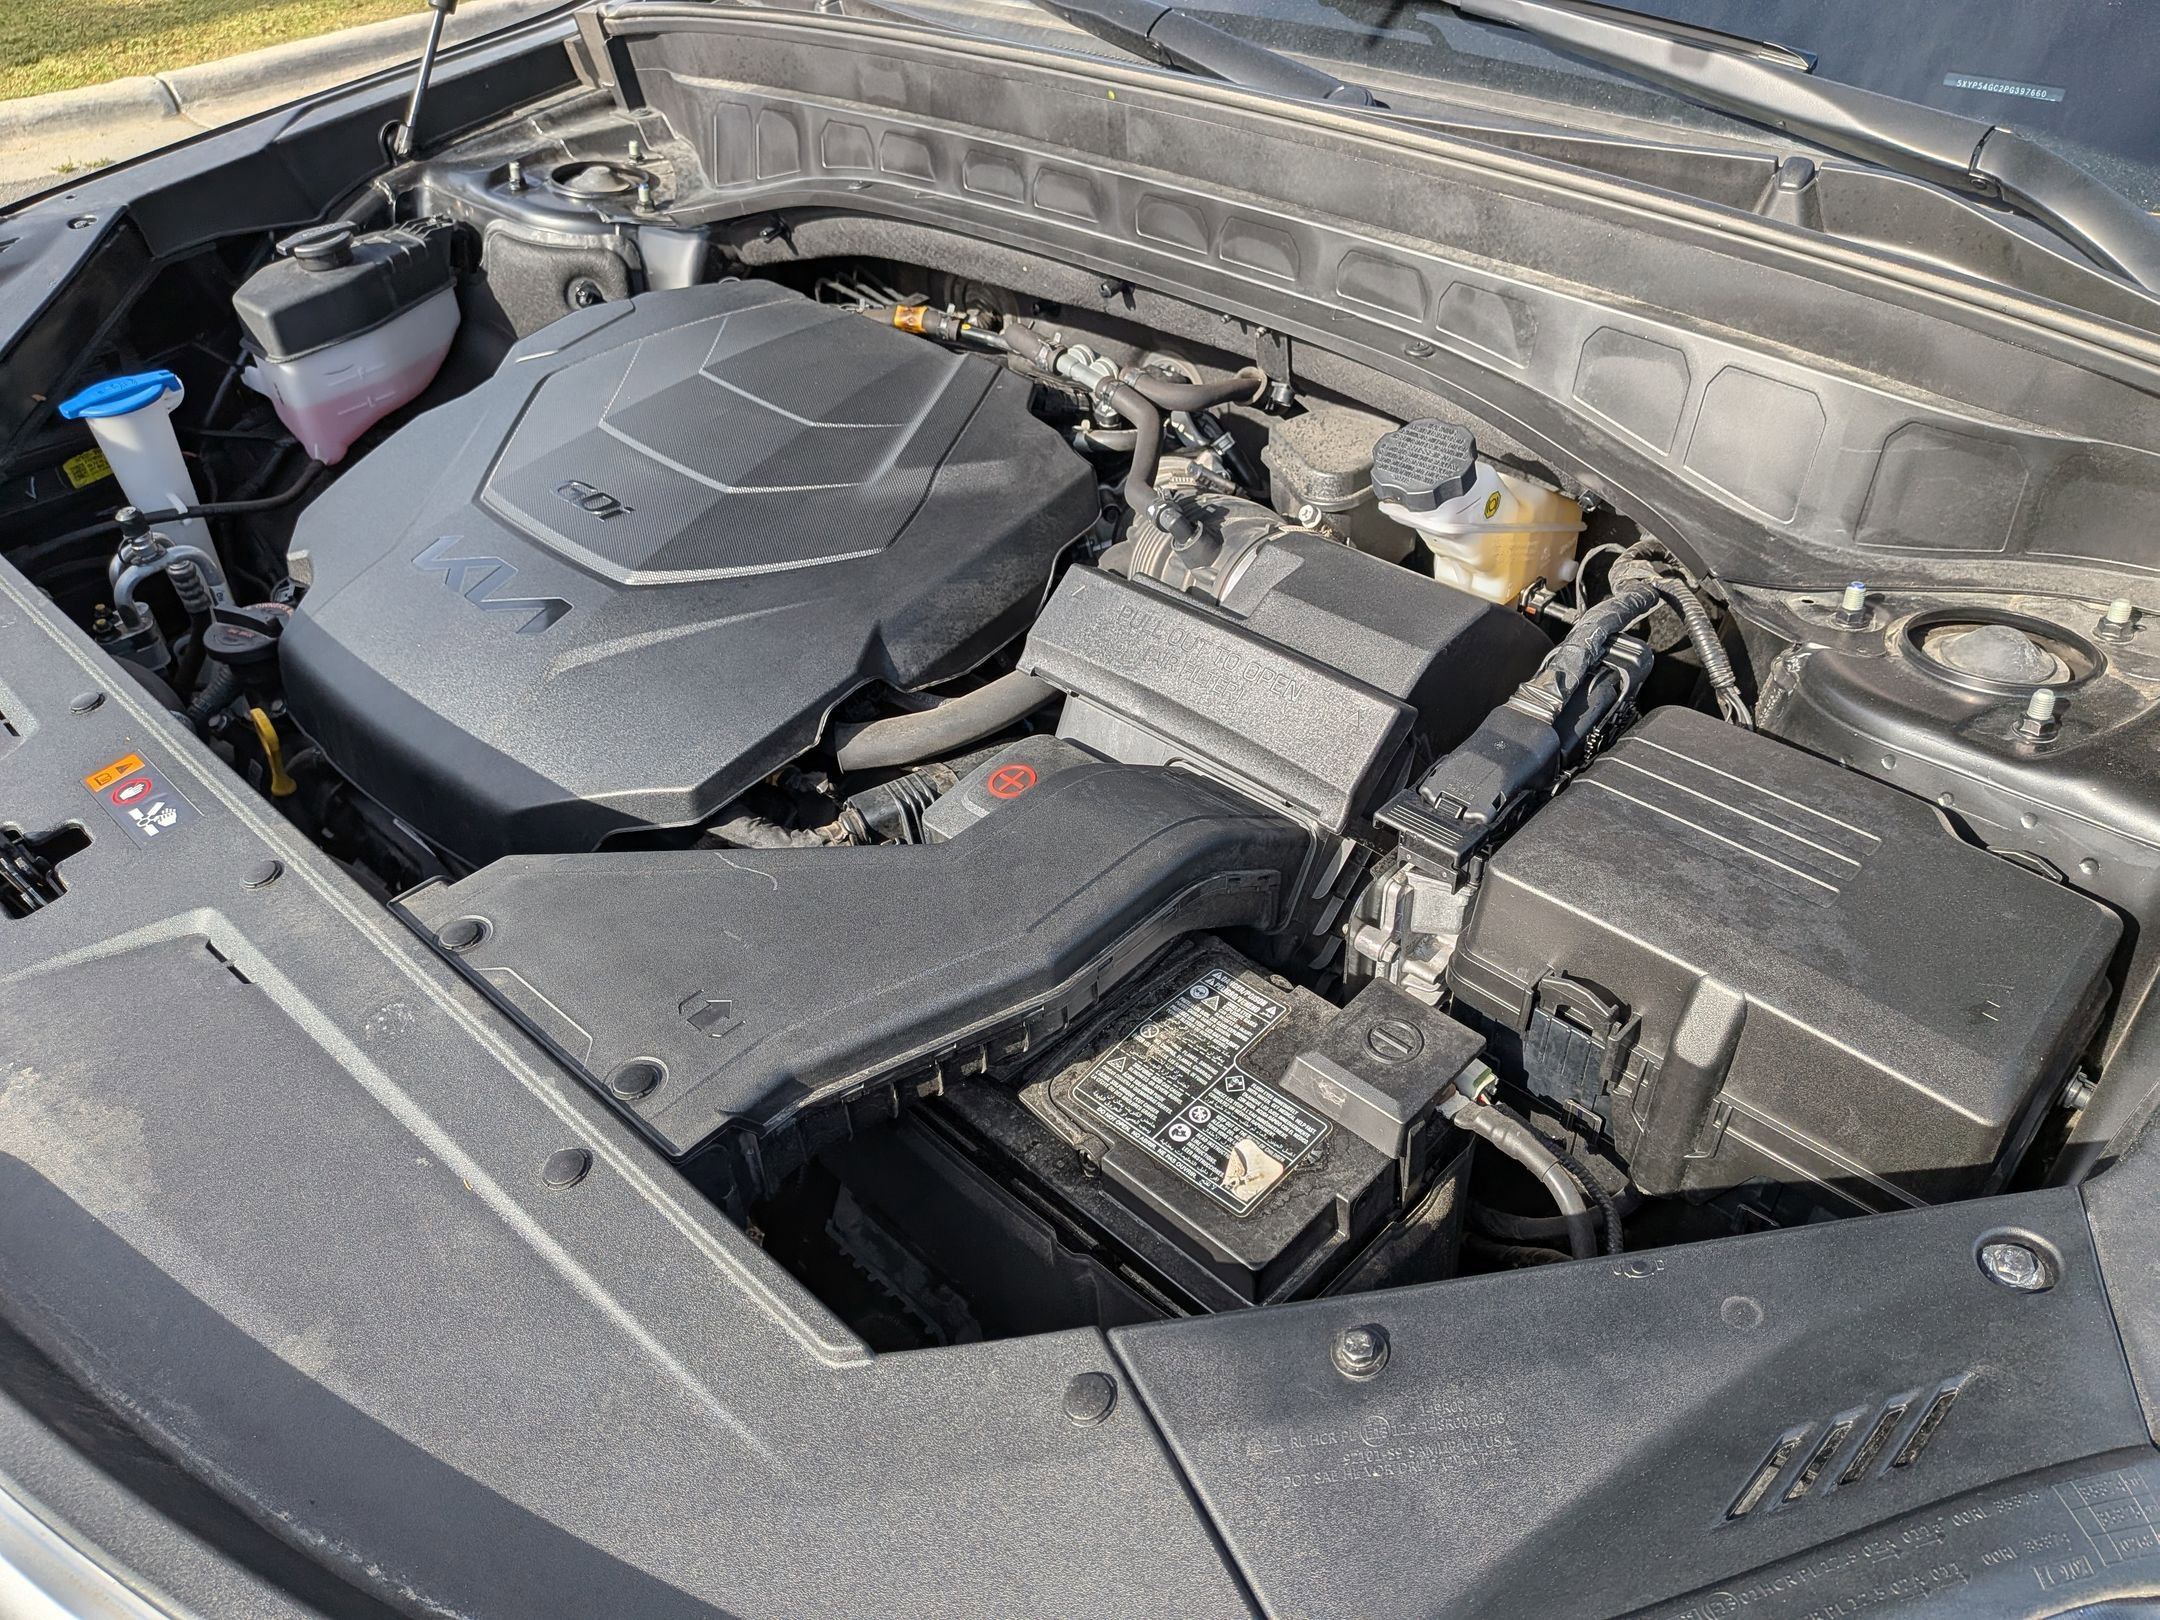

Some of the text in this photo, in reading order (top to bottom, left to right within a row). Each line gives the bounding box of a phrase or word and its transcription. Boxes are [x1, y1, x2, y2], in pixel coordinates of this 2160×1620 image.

[1956, 79, 2047, 98] 5XYP54GC2PG397660
[1118, 605, 1304, 700] PULL OUT TO OPEN
[1104, 1112, 1116, 1121] NOT
[1114, 1119, 1131, 1132] OPEN.
[1130, 1130, 1140, 1138] NO
[1138, 1136, 1157, 1150] ABRIR.
[1156, 1148, 1166, 1156] NE
[1164, 1153, 1176, 1163] PAS
[1174, 1161, 1197, 1178] OUVRIR.
[1311, 1433, 1336, 1446] HCR
[1485, 1435, 1513, 1449] USA
[1283, 1473, 1309, 1488] DOT
[1314, 1470, 1338, 1485] SAE
